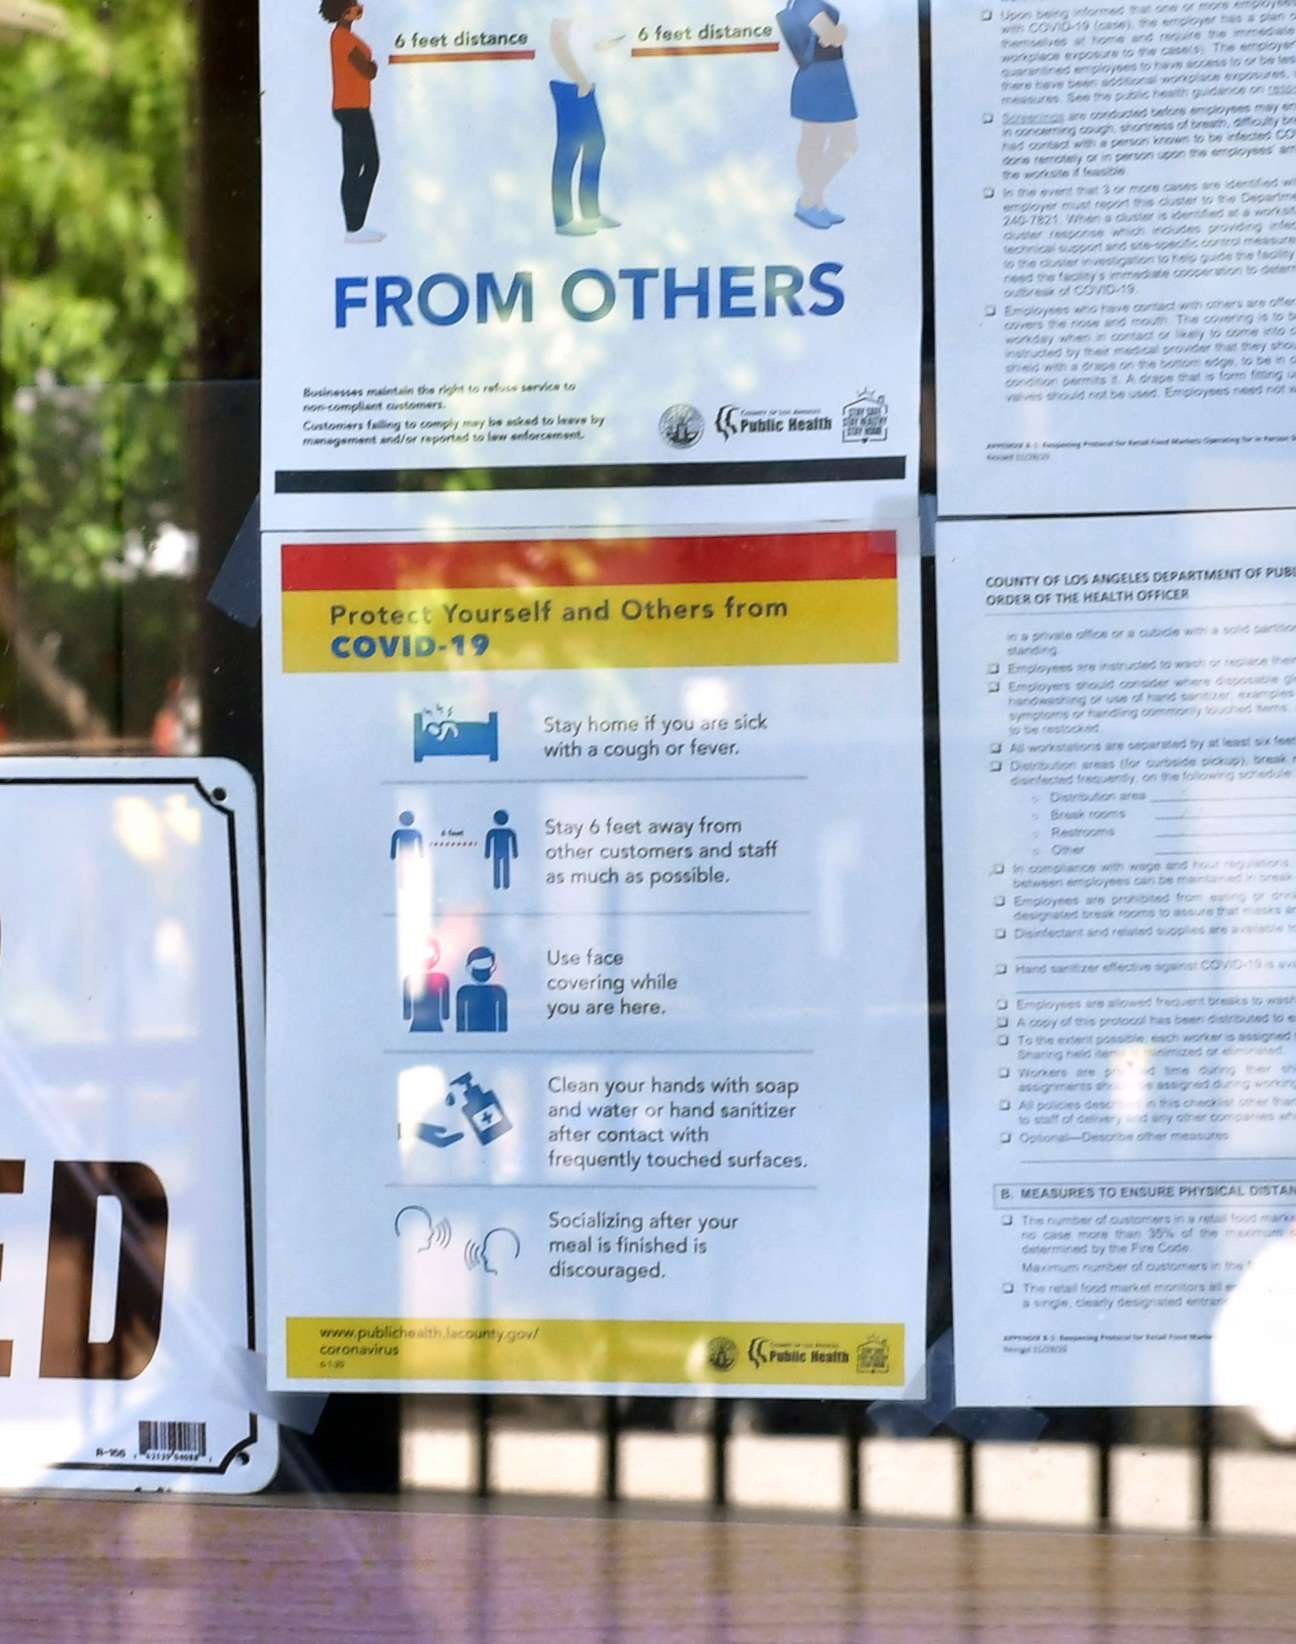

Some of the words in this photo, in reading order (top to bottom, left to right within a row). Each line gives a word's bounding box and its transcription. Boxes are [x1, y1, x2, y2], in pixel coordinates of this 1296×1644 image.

[393, 32, 406, 49] 6
[410, 31, 448, 48] feet
[453, 31, 529, 46] distance
[637, 26, 649, 42] 6
[653, 24, 692, 42] feet
[696, 23, 773, 41] distance
[334, 271, 533, 327] FROM
[560, 263, 845, 321] OTHERS
[302, 386, 364, 398] Businesses
[365, 385, 415, 397] maintain
[416, 383, 435, 396] the
[437, 383, 465, 397] right
[467, 384, 480, 394] to
[482, 381, 518, 393] refuse
[520, 381, 561, 393] service
[562, 381, 577, 391] to
[301, 400, 383, 413] non-compliant
[385, 400, 446, 411] customers.
[301, 420, 364, 431] Customers
[365, 418, 402, 433] failing
[403, 419, 417, 430] to
[418, 418, 459, 431] comply
[461, 419, 486, 430] may
[487, 416, 503, 428] be
[505, 415, 539, 427] asked
[541, 415, 555, 426] to
[555, 413, 588, 426] leave
[589, 413, 606, 428] by
[739, 418, 784, 433] Public
[787, 416, 833, 431] Health
[301, 435, 377, 448] management
[379, 433, 418, 445] and/or
[419, 432, 470, 445] reported
[472, 433, 485, 442] to
[486, 430, 508, 442] law
[509, 429, 585, 441] enforcement.
[984, 575, 1040, 588] COUNTY
[1042, 574, 1061, 587] OF
[1063, 573, 1089, 586] LOS
[1090, 571, 1150, 585] ANGELES
[1151, 567, 1243, 583] DEPARTMENT
[1243, 566, 1263, 580] OF
[985, 593, 1032, 606] ORDER
[1033, 592, 1052, 605] OF
[1054, 591, 1079, 604] THE
[1082, 590, 1134, 603] HEALTH
[1135, 588, 1189, 602] OFFICER
[330, 604, 431, 626] Protect
[442, 600, 551, 624] Yourself
[561, 599, 610, 622] and
[620, 598, 715, 621] Others
[723, 595, 788, 618] from
[330, 632, 491, 658] COVID-19
[543, 715, 583, 738] Stay
[587, 715, 639, 736] home
[644, 713, 657, 732] if
[661, 718, 694, 736] you
[700, 719, 728, 731] are
[733, 712, 768, 730] sick
[543, 740, 583, 758] with
[586, 744, 598, 758] a
[602, 739, 660, 761] cough
[664, 743, 686, 756] or
[688, 738, 740, 756] fever.
[544, 817, 584, 839] Stay
[588, 817, 601, 835] 6
[605, 816, 642, 835] feet
[647, 820, 695, 839] away
[697, 815, 743, 834] from
[544, 842, 594, 860] other
[599, 845, 694, 860] customers
[697, 840, 733, 859] and
[737, 839, 779, 858] staff
[545, 871, 565, 885] as
[569, 866, 620, 885] much
[624, 870, 644, 884] as
[649, 865, 730, 887] possible.
[546, 949, 581, 966] Use
[585, 948, 624, 967] face
[546, 973, 625, 995] covering
[629, 972, 679, 990] while
[546, 1002, 580, 1020] you
[584, 1001, 615, 1016] are
[619, 997, 666, 1015] here.
[546, 1075, 600, 1094] Clean
[603, 1079, 646, 1099] your
[650, 1075, 706, 1094] hands
[709, 1076, 750, 1094] with
[754, 1080, 800, 1099] soap
[547, 1101, 582, 1118] and
[586, 1102, 639, 1118] water
[644, 1103, 665, 1118] or
[668, 1100, 716, 1119] hand
[719, 1101, 797, 1119] sanitizer
[547, 1125, 592, 1142] after
[596, 1127, 665, 1143] contact
[668, 1125, 709, 1143] with
[547, 1149, 642, 1172] frequently
[645, 1149, 722, 1168] touched
[727, 1149, 808, 1168] surfaces.
[1000, 1187, 1013, 1200] B.
[1020, 1186, 1096, 1199] MEASURES
[1097, 1186, 1117, 1199] TO
[1119, 1185, 1175, 1198] ENSURE
[1178, 1185, 1244, 1197] PHYSICAL
[546, 1210, 644, 1233] Socializing
[648, 1211, 693, 1229] after
[697, 1216, 739, 1234] your
[548, 1236, 592, 1253] meal
[597, 1235, 612, 1253] is
[614, 1235, 688, 1254] finished
[692, 1236, 708, 1254] is
[548, 1260, 666, 1283] discouraged.
[319, 1344, 400, 1356] coronavirus
[768, 1349, 807, 1363] Public
[809, 1350, 850, 1363] Health
